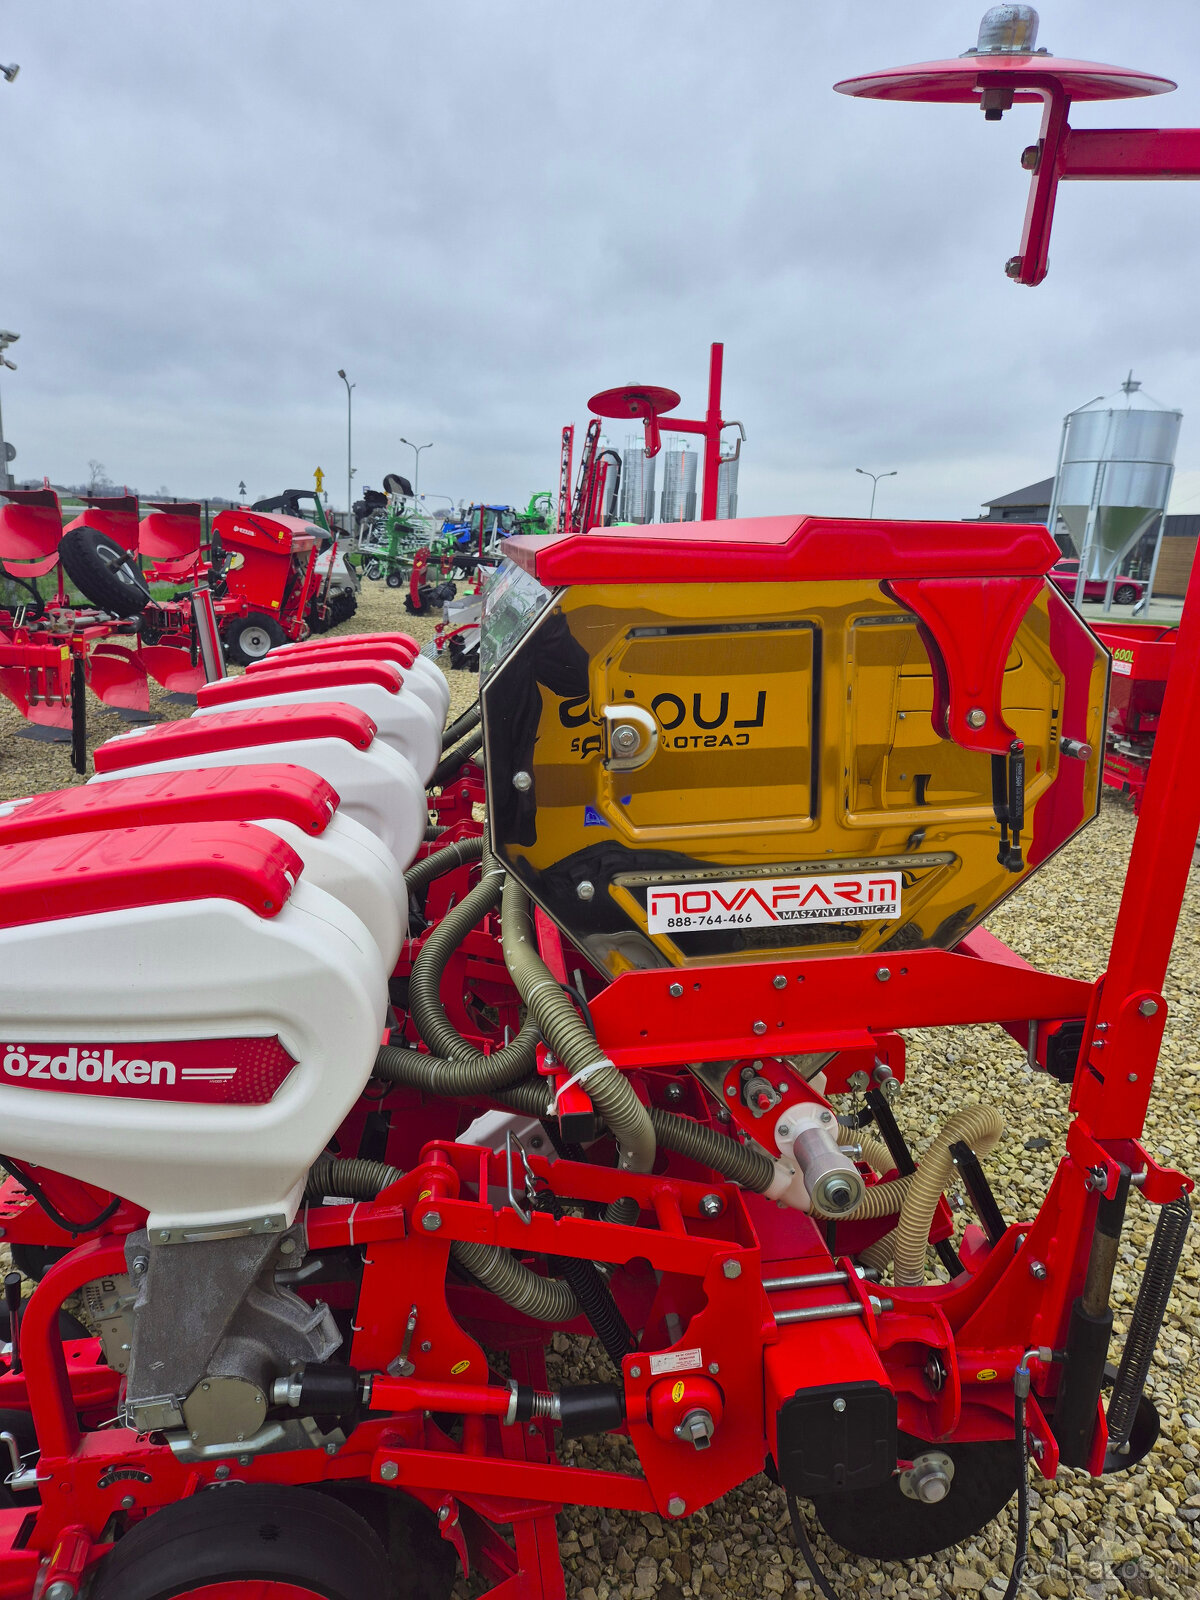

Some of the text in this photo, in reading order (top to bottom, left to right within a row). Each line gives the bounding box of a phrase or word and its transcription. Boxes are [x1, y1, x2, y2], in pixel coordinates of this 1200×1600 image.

[1114, 648, 1134, 663] 600L
[651, 879, 897, 921] NOVAFARM
[782, 904, 896, 920] MASZYNY ROLNICZE
[667, 913, 753, 928] 888-764-466
[3, 1045, 176, 1085] özdöken
[102, 1280, 116, 1292] B
